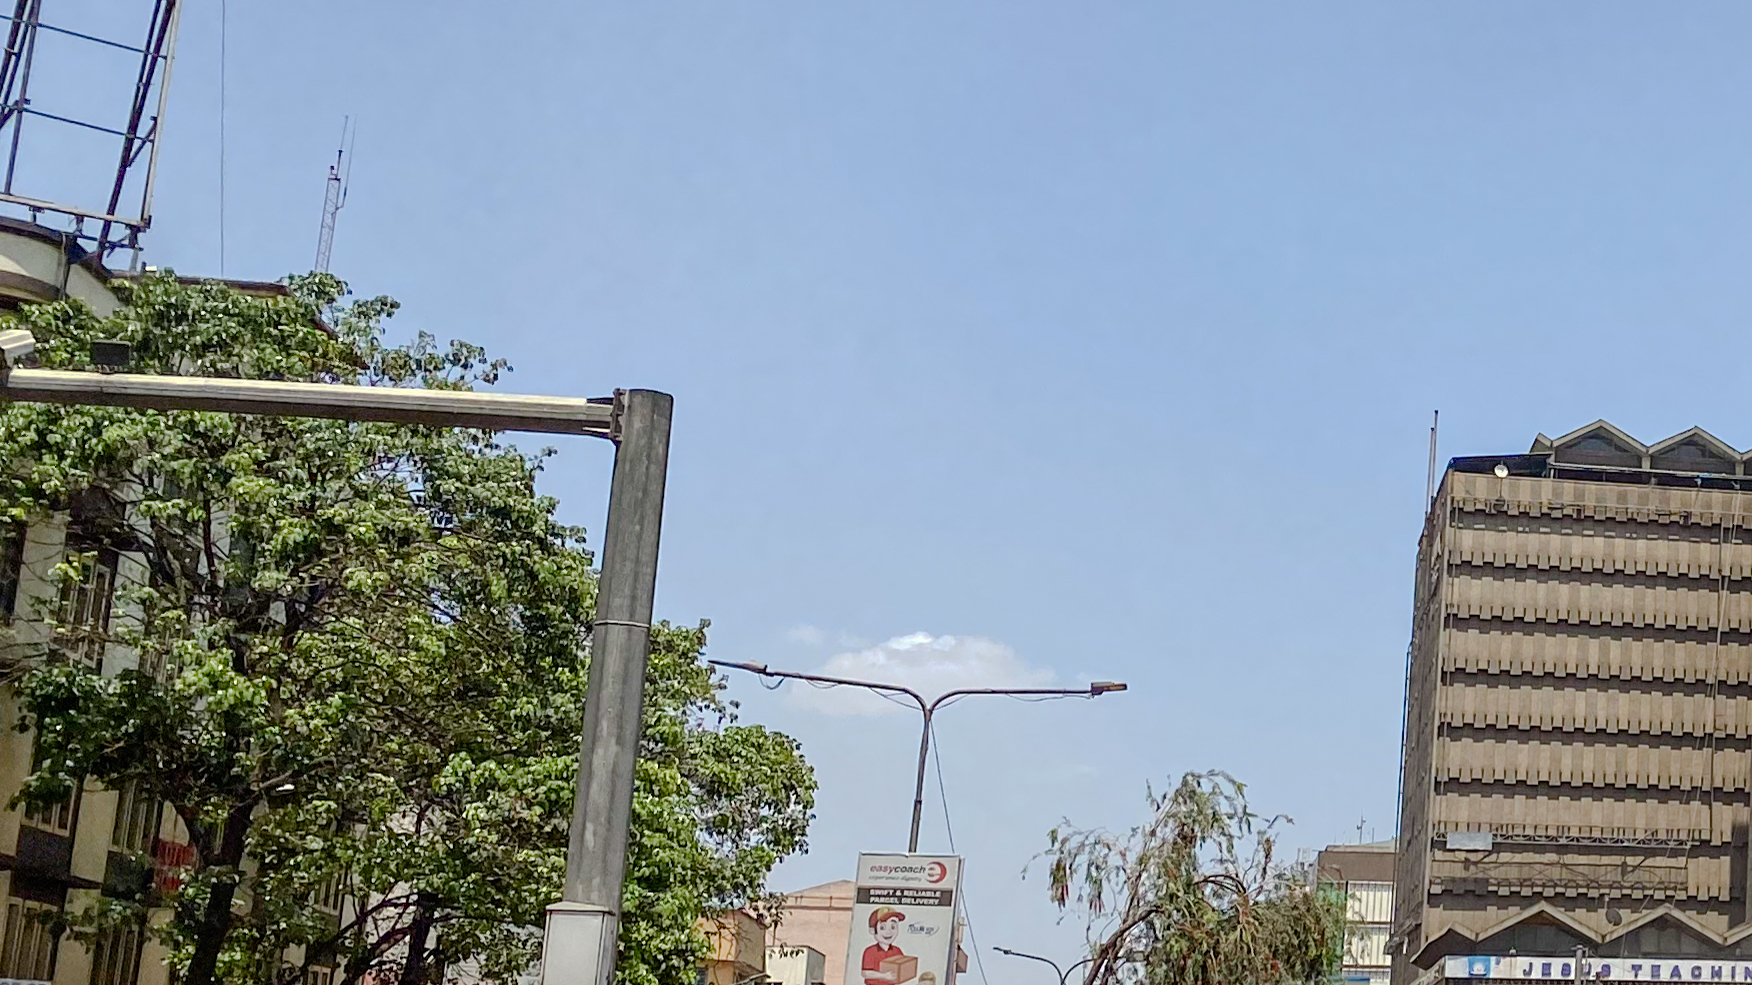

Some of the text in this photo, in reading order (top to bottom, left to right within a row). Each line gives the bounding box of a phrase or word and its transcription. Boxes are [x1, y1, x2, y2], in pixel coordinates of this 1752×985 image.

[870, 864, 926, 875] easycoach
[869, 888, 894, 896] SWIFT
[901, 898, 940, 906] DELIVERY
